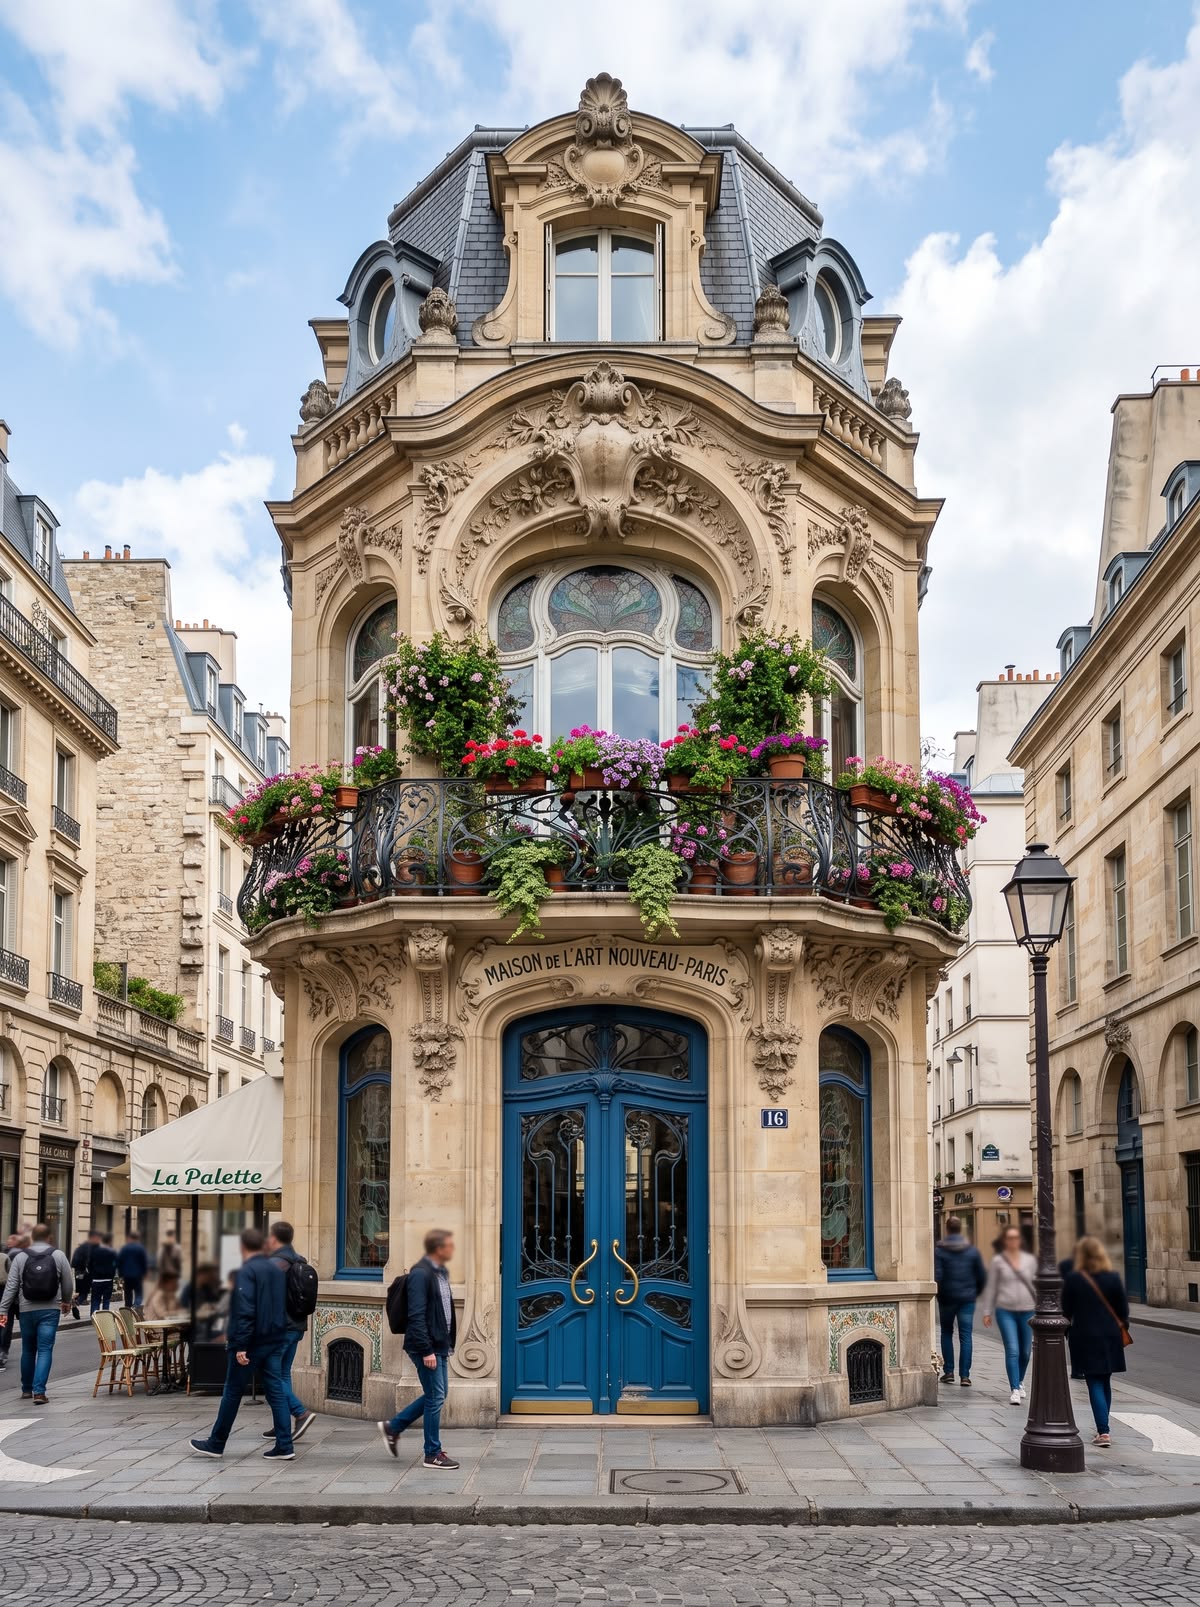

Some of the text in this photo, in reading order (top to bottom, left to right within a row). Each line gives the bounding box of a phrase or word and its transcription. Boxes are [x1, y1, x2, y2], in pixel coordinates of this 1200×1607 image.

[484, 947, 729, 986] MAISON DE L'ART NOUVEAU-PARIS
[767, 1111, 784, 1126] 16
[151, 1167, 263, 1185] La Palette
